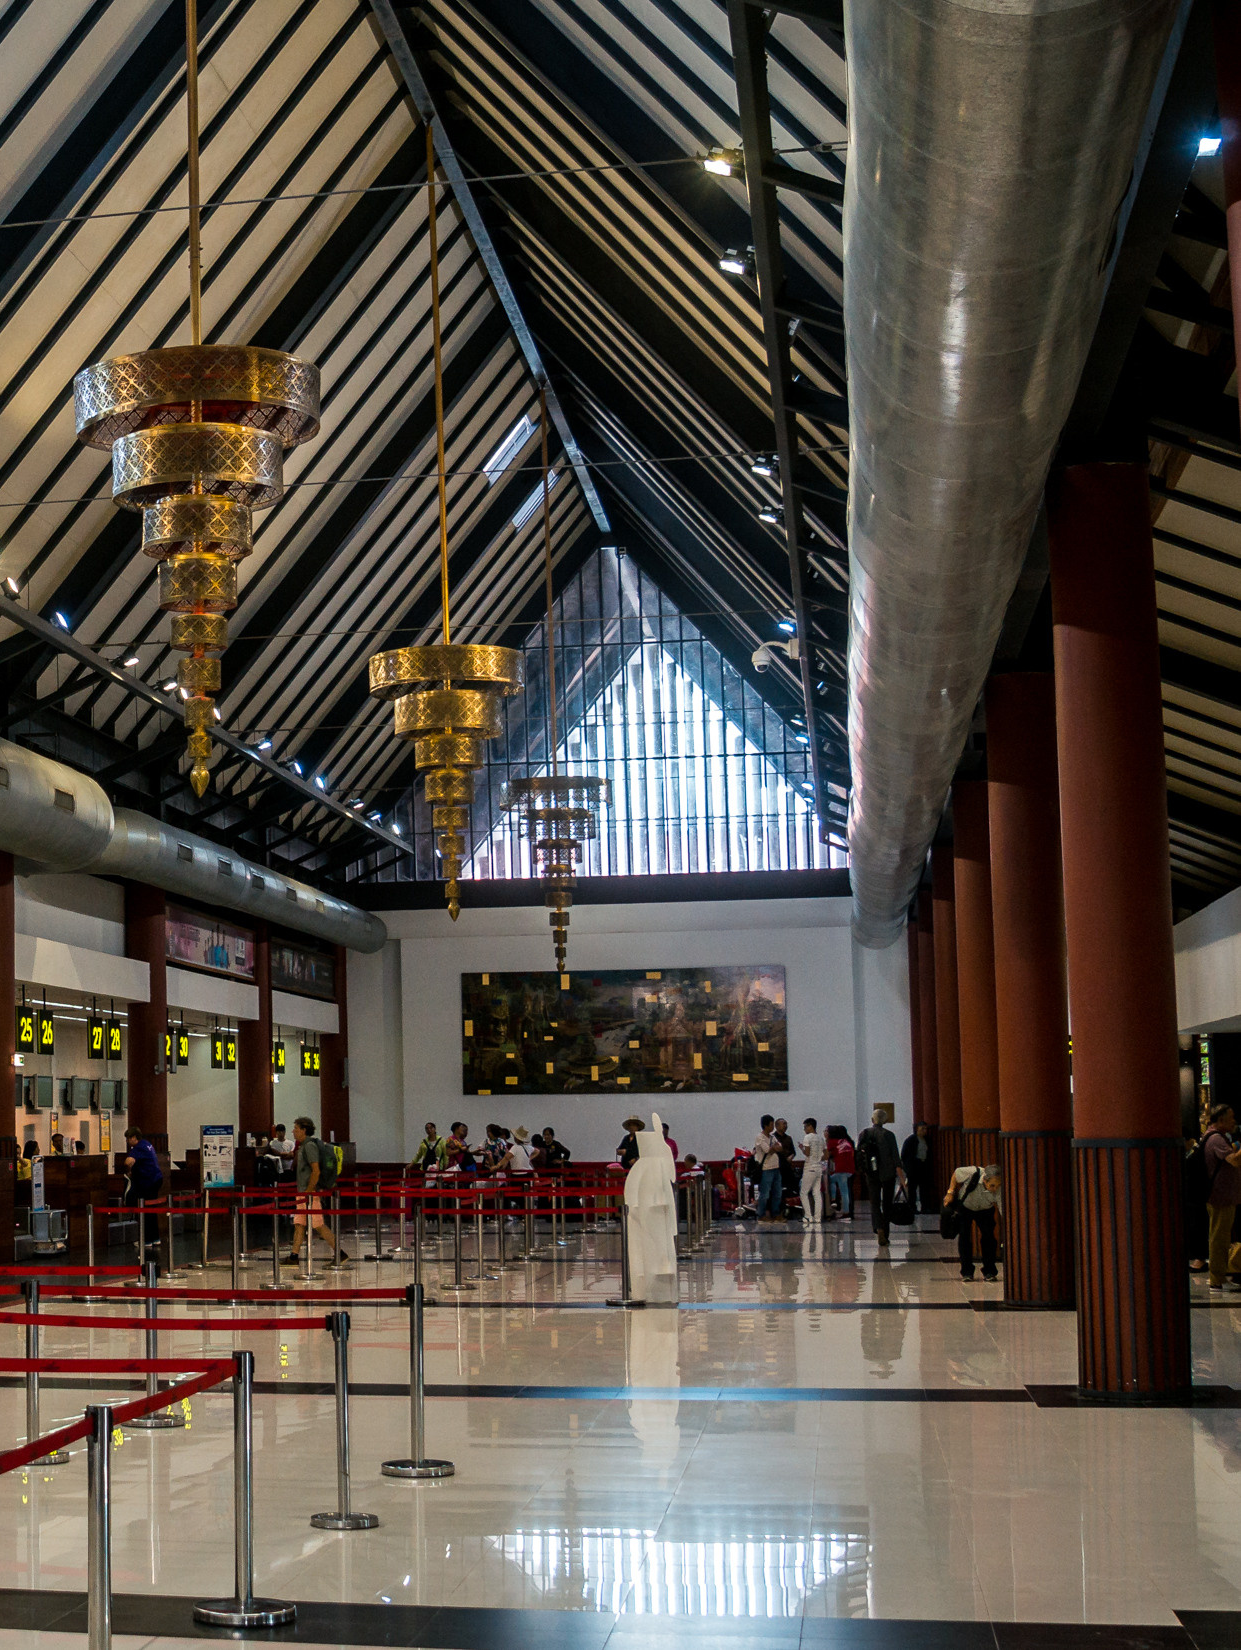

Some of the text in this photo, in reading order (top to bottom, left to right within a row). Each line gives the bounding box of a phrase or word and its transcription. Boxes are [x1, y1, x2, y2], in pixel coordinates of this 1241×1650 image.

[20, 1016, 33, 1043] 25
[42, 1020, 54, 1045] 26
[93, 1026, 103, 1050] 27
[110, 1028, 121, 1051] 28
[179, 1036, 189, 1058] 30
[215, 1041, 222, 1061] 31
[227, 1042, 236, 1062] 32
[277, 1048, 285, 1067] 34
[303, 1051, 311, 1070] 35
